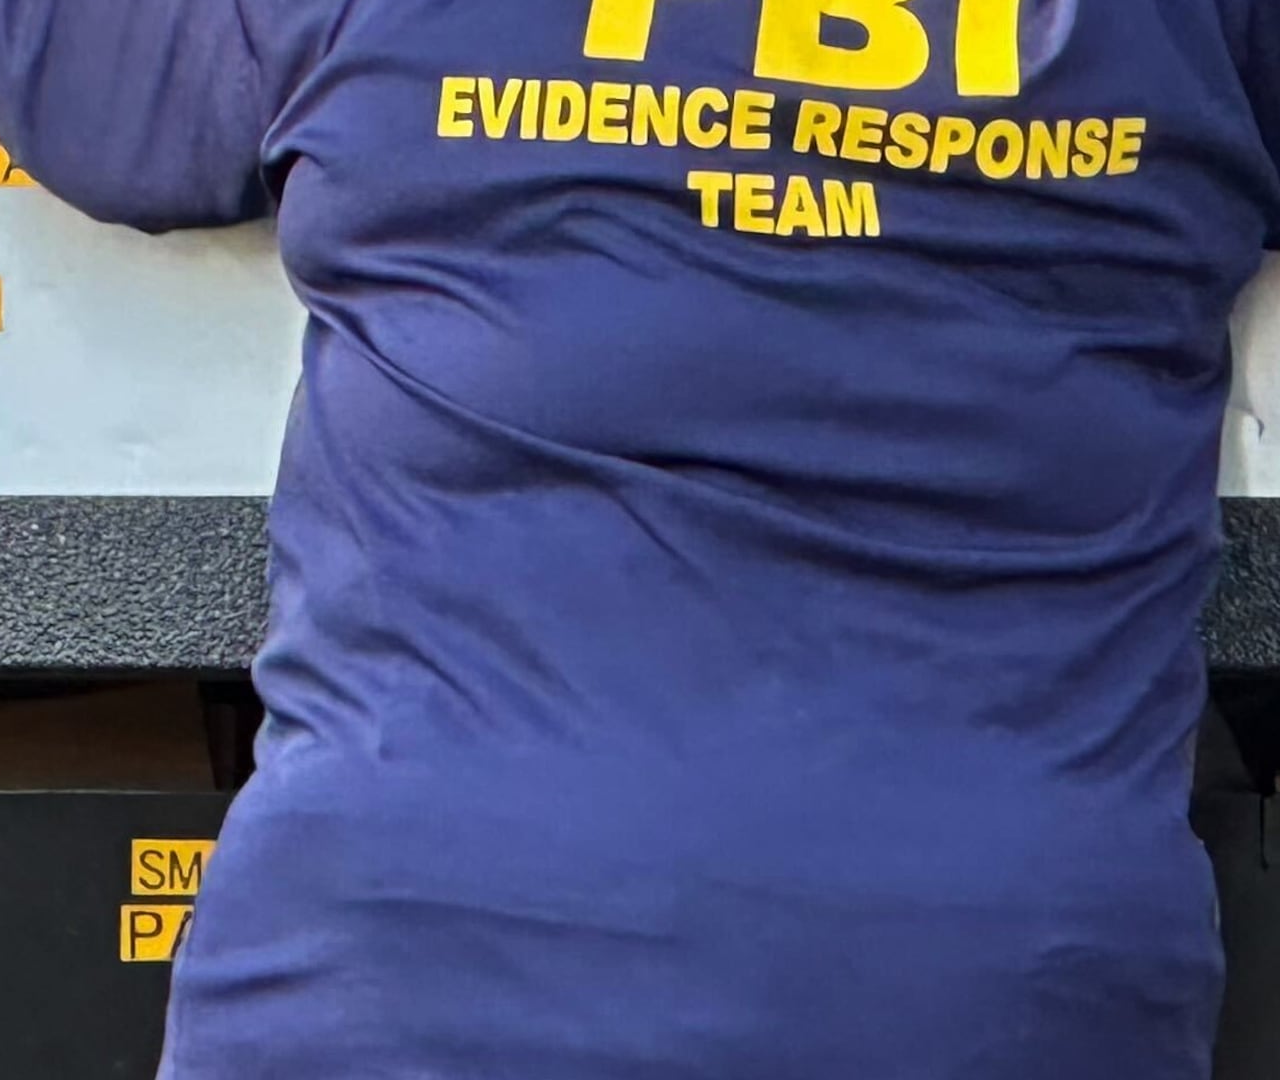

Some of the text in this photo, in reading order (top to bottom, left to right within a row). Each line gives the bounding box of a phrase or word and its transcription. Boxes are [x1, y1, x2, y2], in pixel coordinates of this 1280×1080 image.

[437, 77, 1146, 180] EVIDENCE RESPONSE
[688, 170, 880, 237] TEAM
